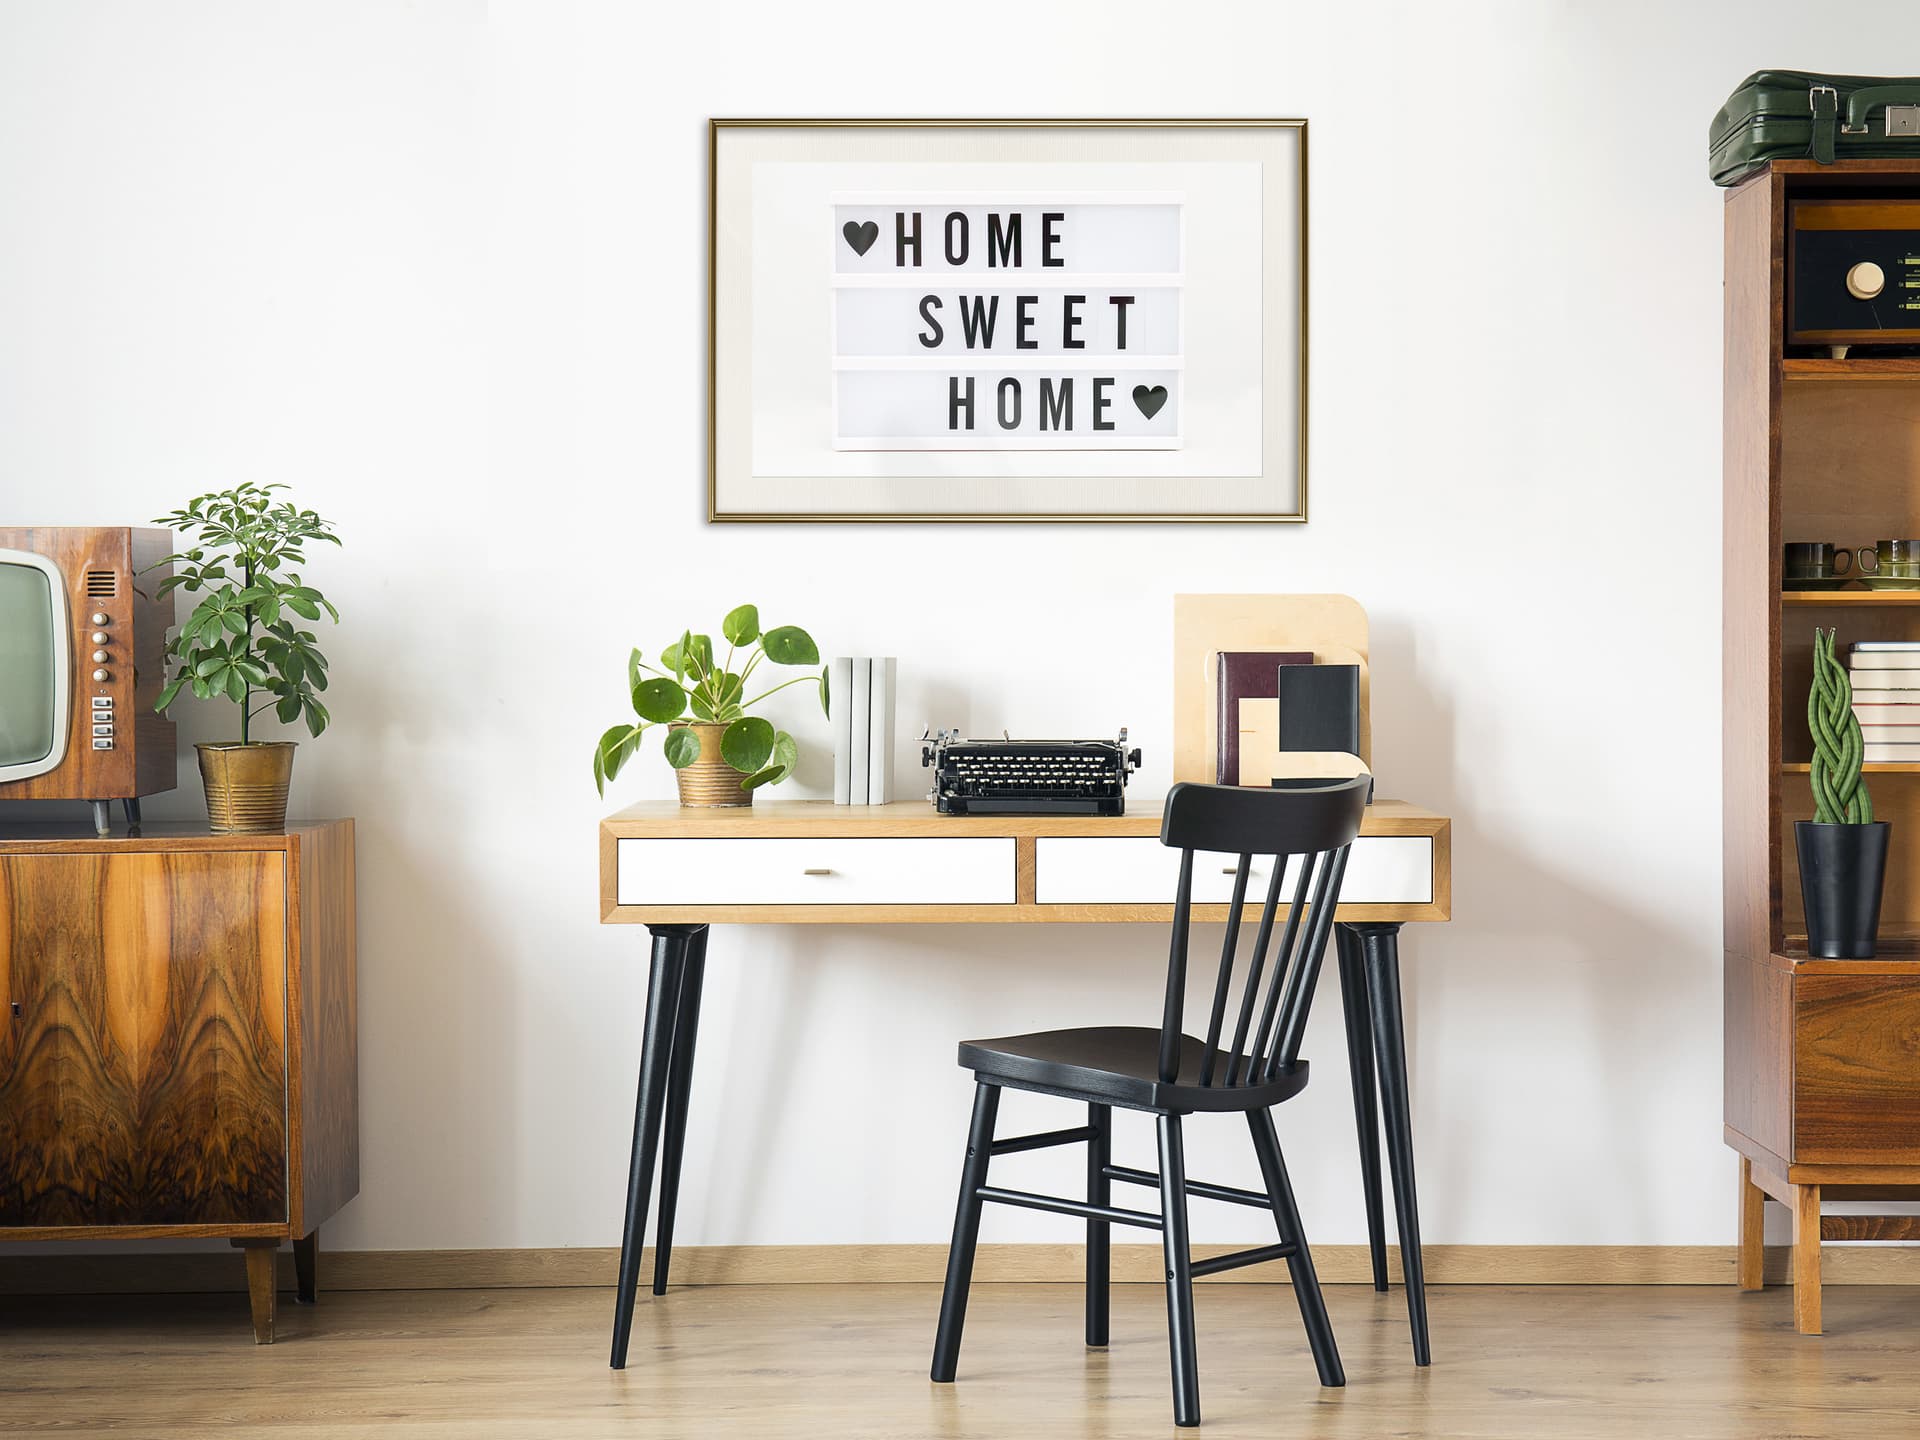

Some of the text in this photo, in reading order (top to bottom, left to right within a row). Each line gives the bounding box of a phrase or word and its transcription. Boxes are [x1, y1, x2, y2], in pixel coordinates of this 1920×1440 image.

[895, 211, 1065, 268] HOME
[918, 294, 1135, 350] SWEET
[948, 376, 1116, 431] HOME
